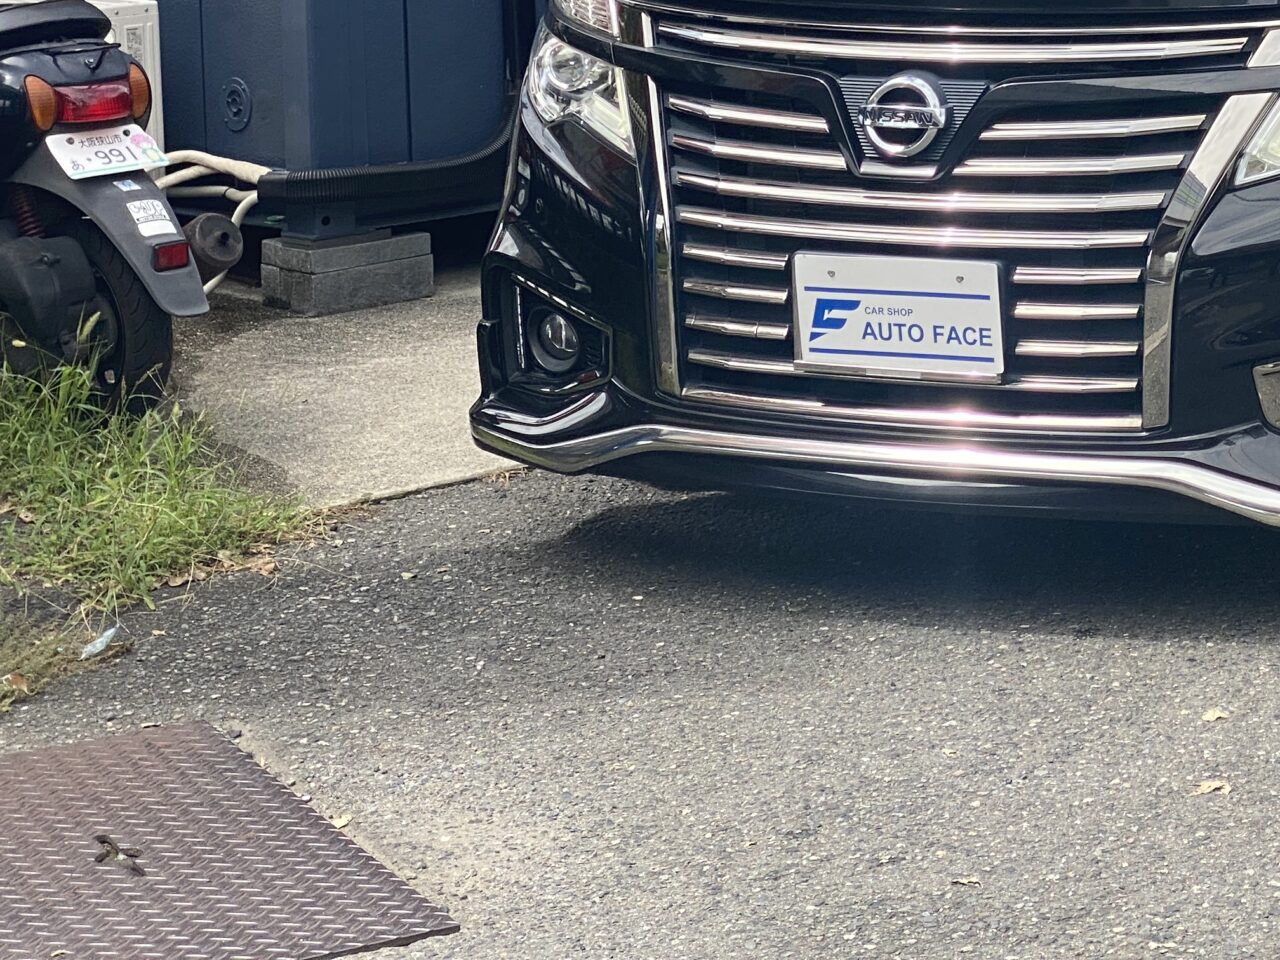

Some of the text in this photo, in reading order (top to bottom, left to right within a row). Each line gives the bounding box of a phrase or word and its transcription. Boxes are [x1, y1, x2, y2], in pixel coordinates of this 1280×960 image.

[865, 109, 934, 126] NISSAN
[71, 160, 85, 171] あ
[864, 306, 913, 317] CAR SHOP
[862, 321, 993, 347] AUTO FACE
